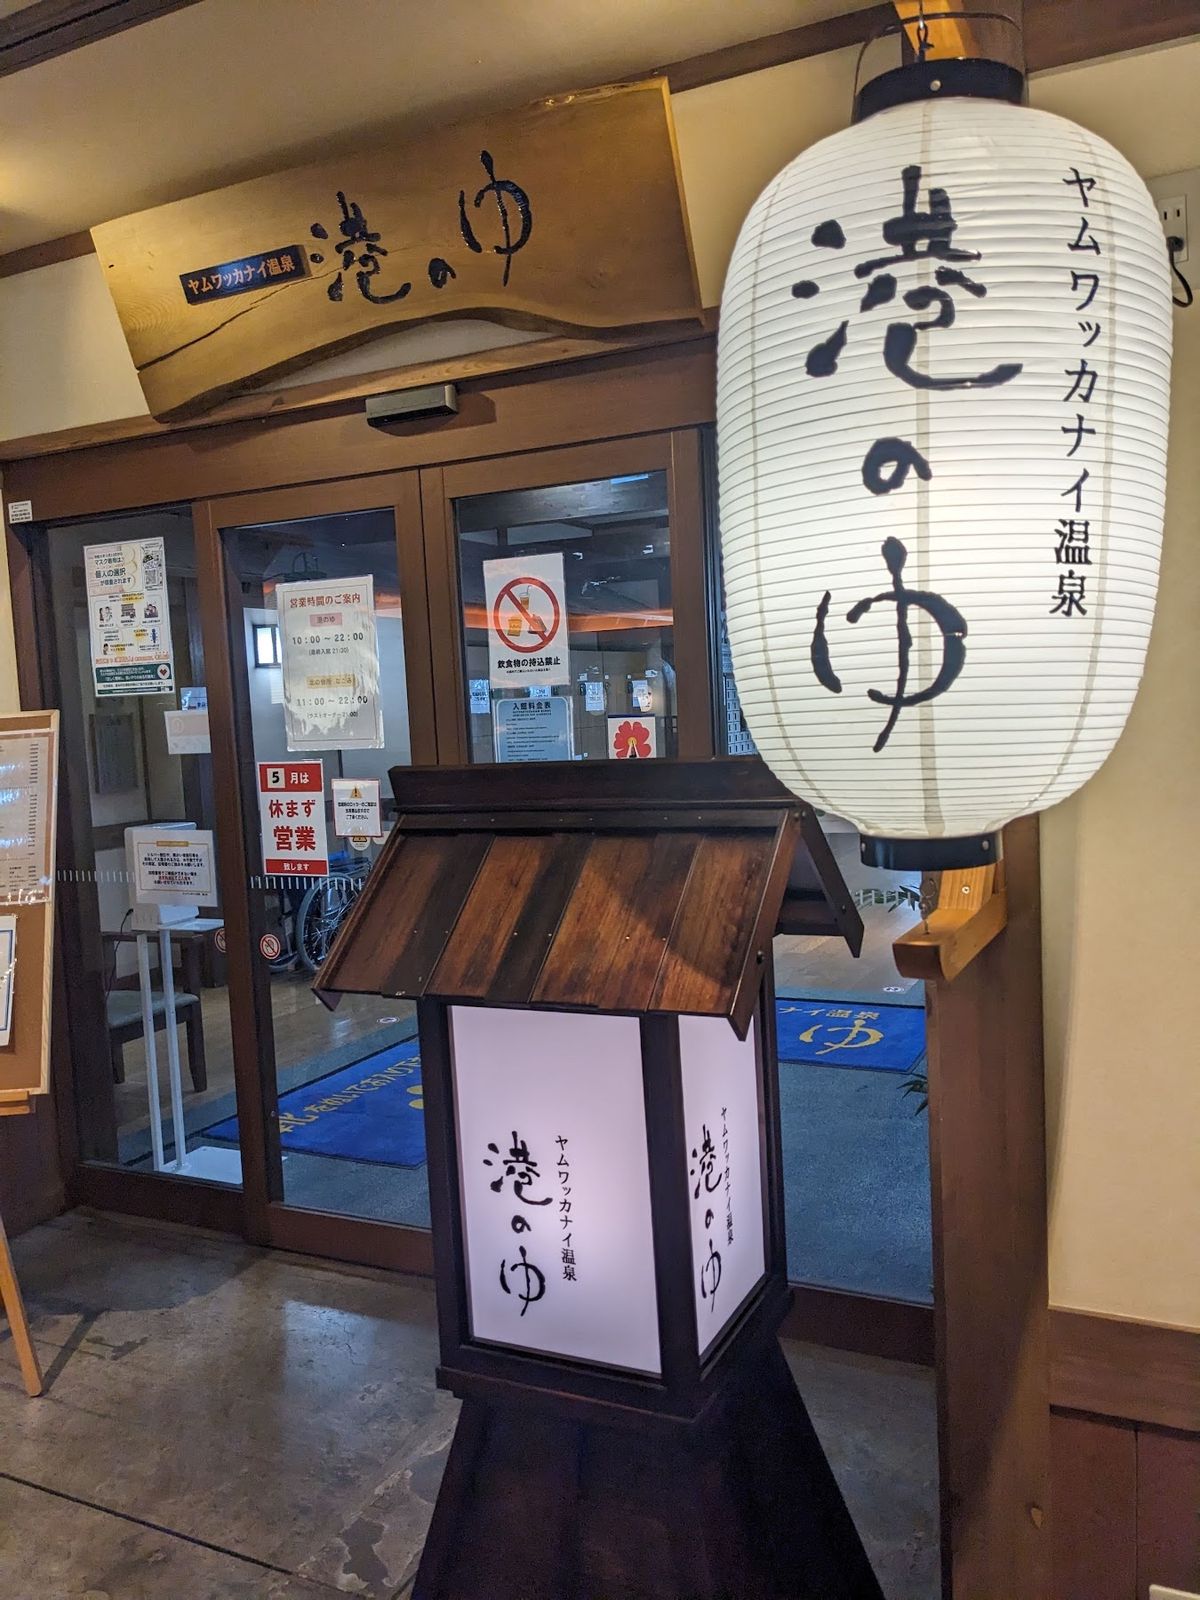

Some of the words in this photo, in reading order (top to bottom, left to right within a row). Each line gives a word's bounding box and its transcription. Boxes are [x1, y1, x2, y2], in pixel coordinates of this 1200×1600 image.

[309, 150, 533, 304] 港のゆ
[186, 255, 296, 295] ヤムワッカナイ温泉
[1049, 166, 1100, 618] ヤムワッカナイ温泉
[791, 165, 1022, 753] 港のゆ
[290, 593, 361, 608] 営業時間のご案内
[497, 656, 561, 668] 飲食物の持込禁止
[272, 771, 280, 784] 5
[290, 772, 310, 785] 月は
[268, 799, 316, 819] 休まず
[273, 825, 316, 851] 営業
[283, 862, 310, 871] 致します
[798, 1019, 885, 1055] ゆ
[483, 1130, 553, 1317] 港のゆ
[555, 1135, 578, 1282] ヤムワッカナイ温泉
[689, 1123, 723, 1312] 港のゆ
